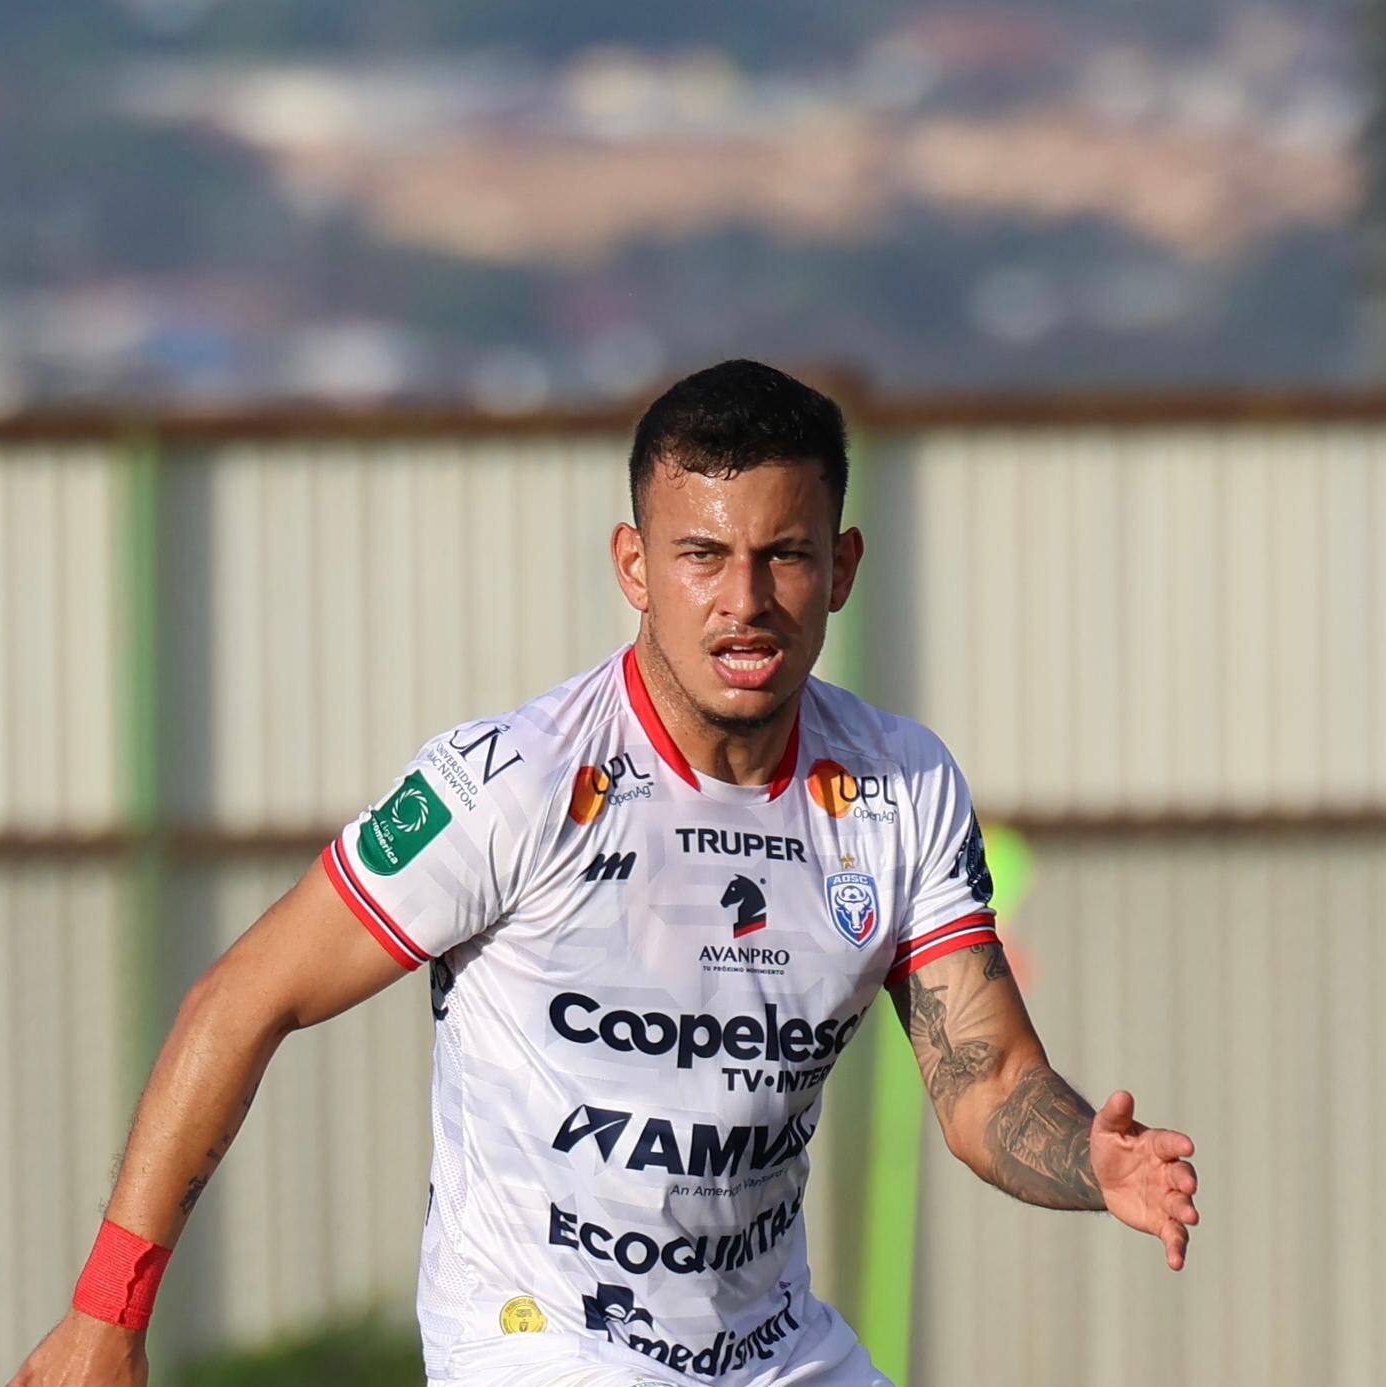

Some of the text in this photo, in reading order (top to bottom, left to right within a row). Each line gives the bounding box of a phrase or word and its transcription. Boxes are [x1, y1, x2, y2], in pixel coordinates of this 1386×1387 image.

[437, 763, 477, 812] NEWTON
[592, 752, 651, 795] UPL
[839, 772, 897, 806] UPL
[372, 816, 399, 865] romerica
[379, 820, 395, 842] Liga
[675, 827, 807, 863] TRUPER
[832, 873, 869, 885] ADSC
[698, 945, 790, 966] AVANPRO
[549, 991, 863, 1069] Coopelesc
[625, 1101, 816, 1178] AMVAC
[670, 1184, 690, 1196] An
[549, 1186, 801, 1275] ECOQUINTAS
